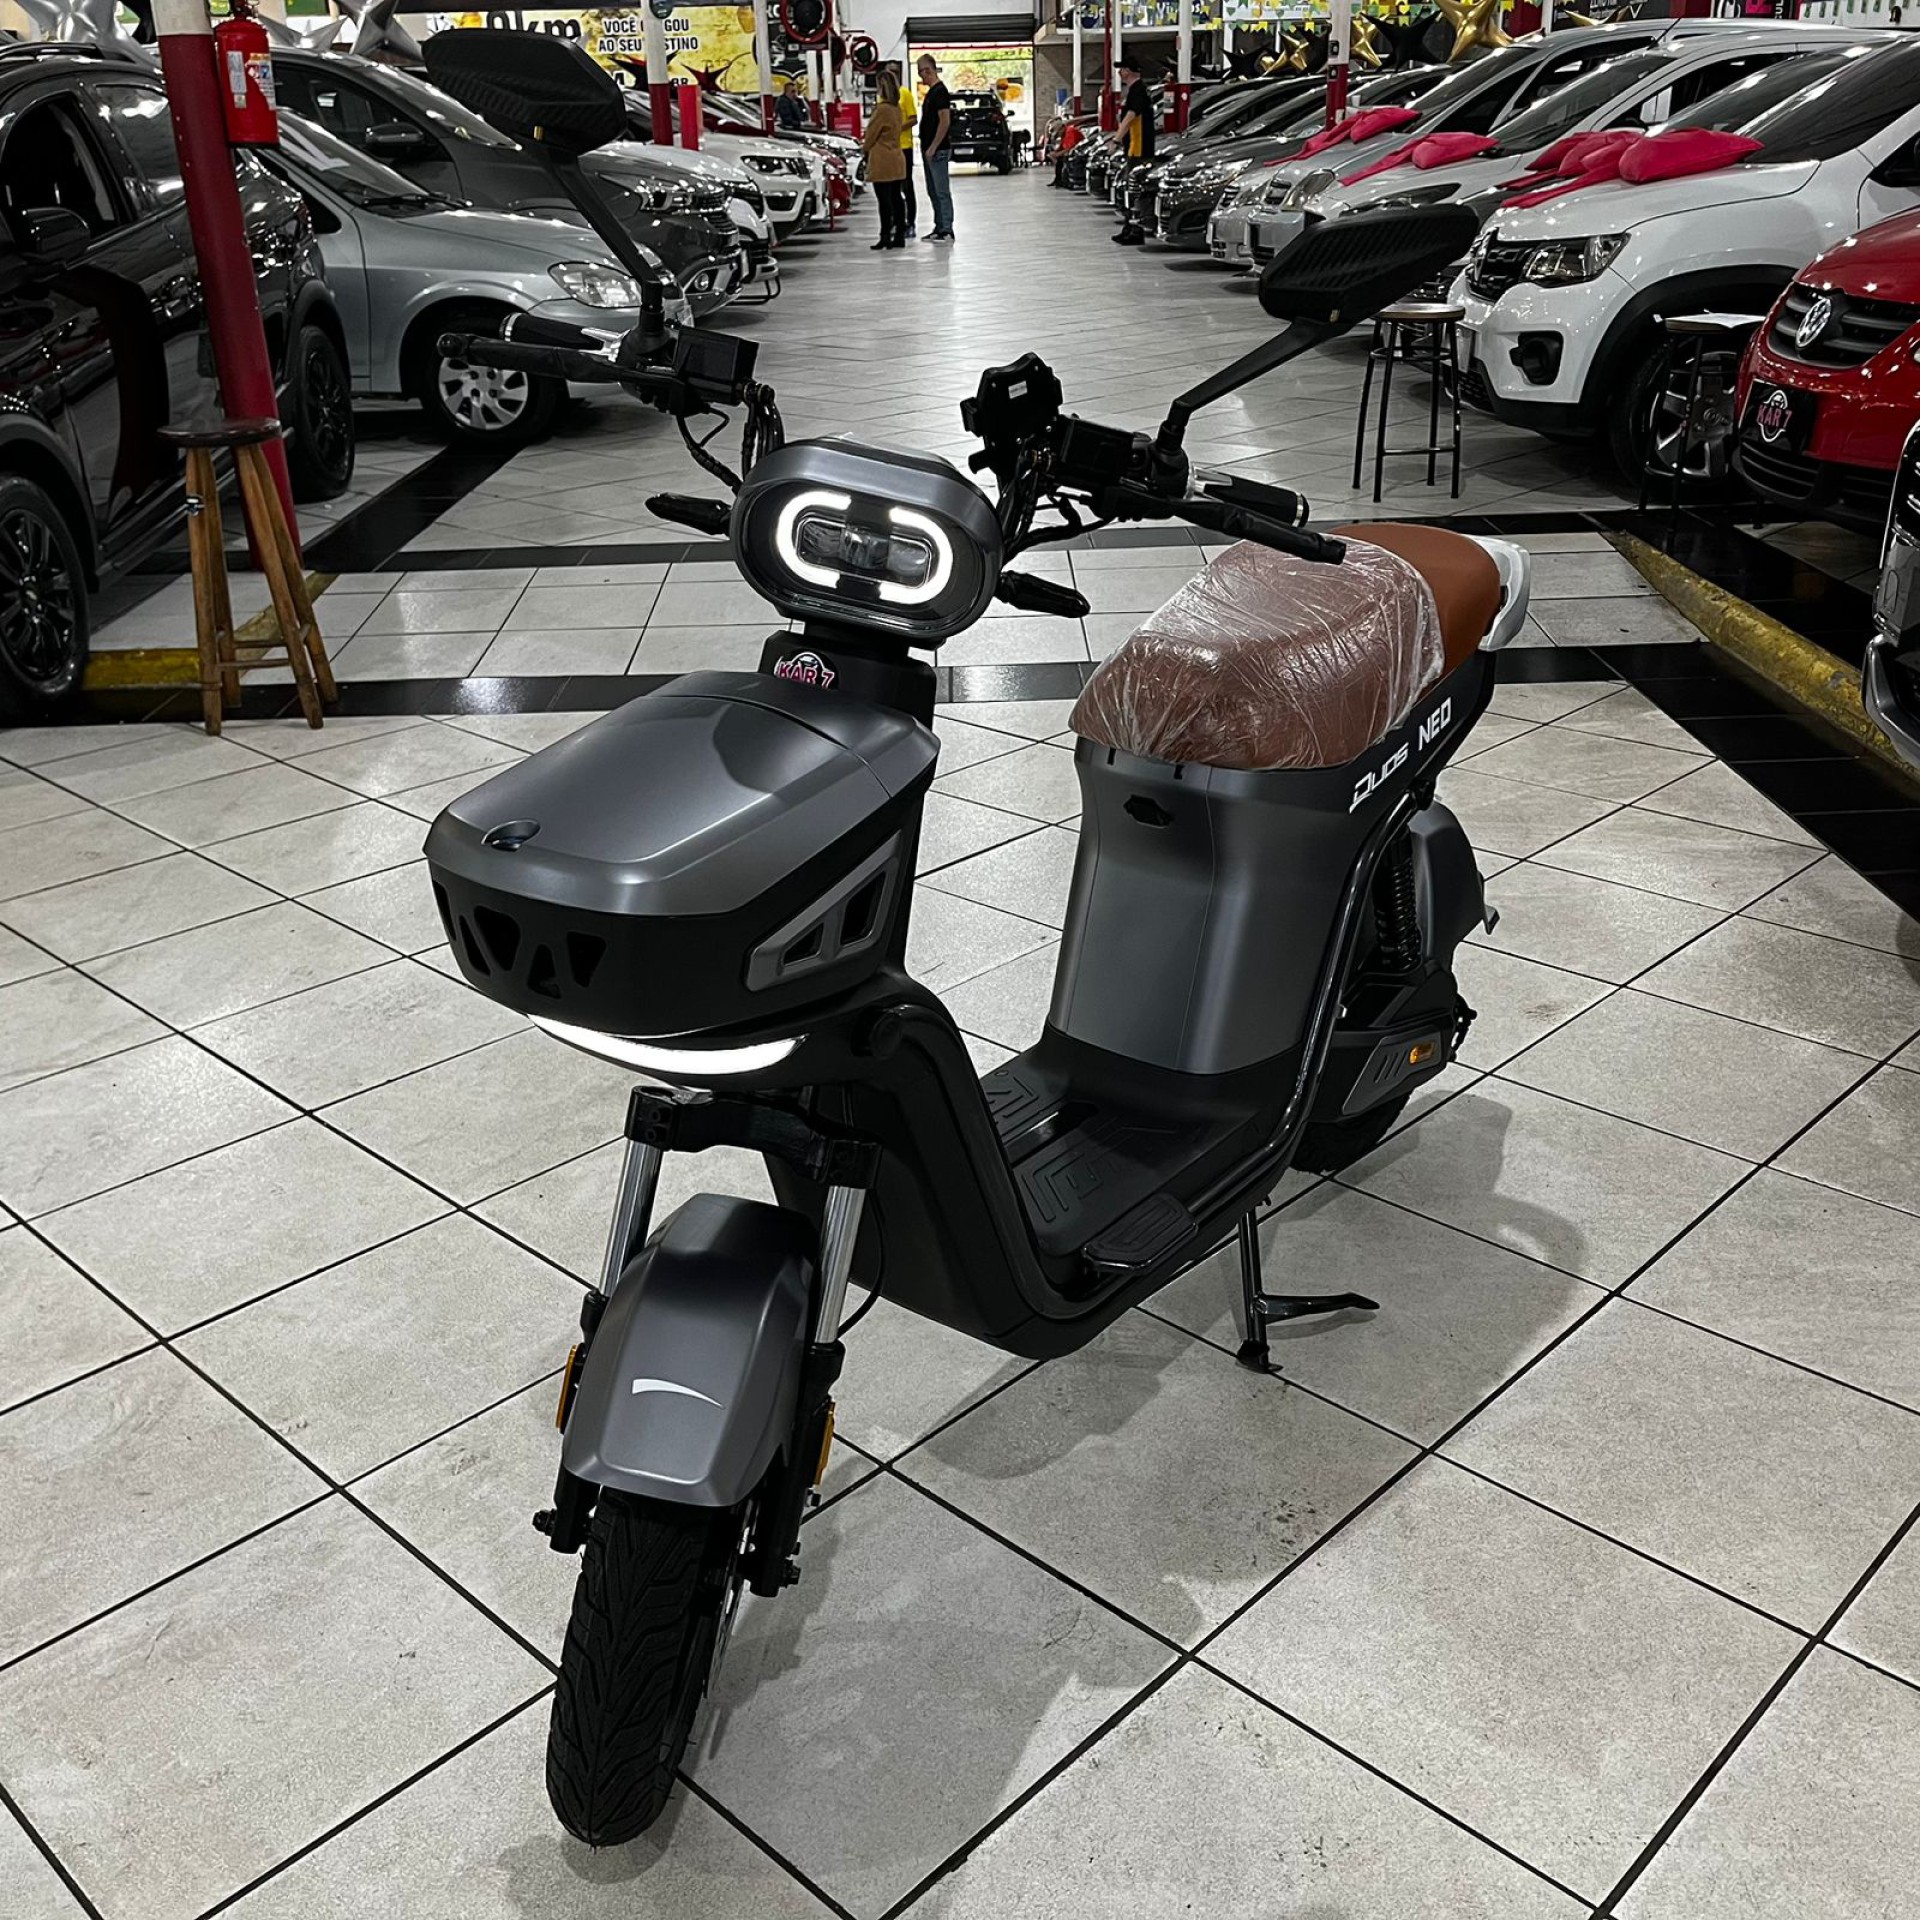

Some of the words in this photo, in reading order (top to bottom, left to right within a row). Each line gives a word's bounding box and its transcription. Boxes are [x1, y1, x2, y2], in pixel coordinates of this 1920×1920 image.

[603, 17, 636, 33] VOCÊ
[641, 18, 690, 32] GOU
[598, 39, 615, 52] AO
[619, 38, 642, 51] SEU
[1757, 404, 1782, 427] KAR
[1783, 409, 1793, 429] 7
[778, 661, 818, 684] KAR
[821, 670, 835, 689] 7
[1418, 696, 1452, 751] NEO
